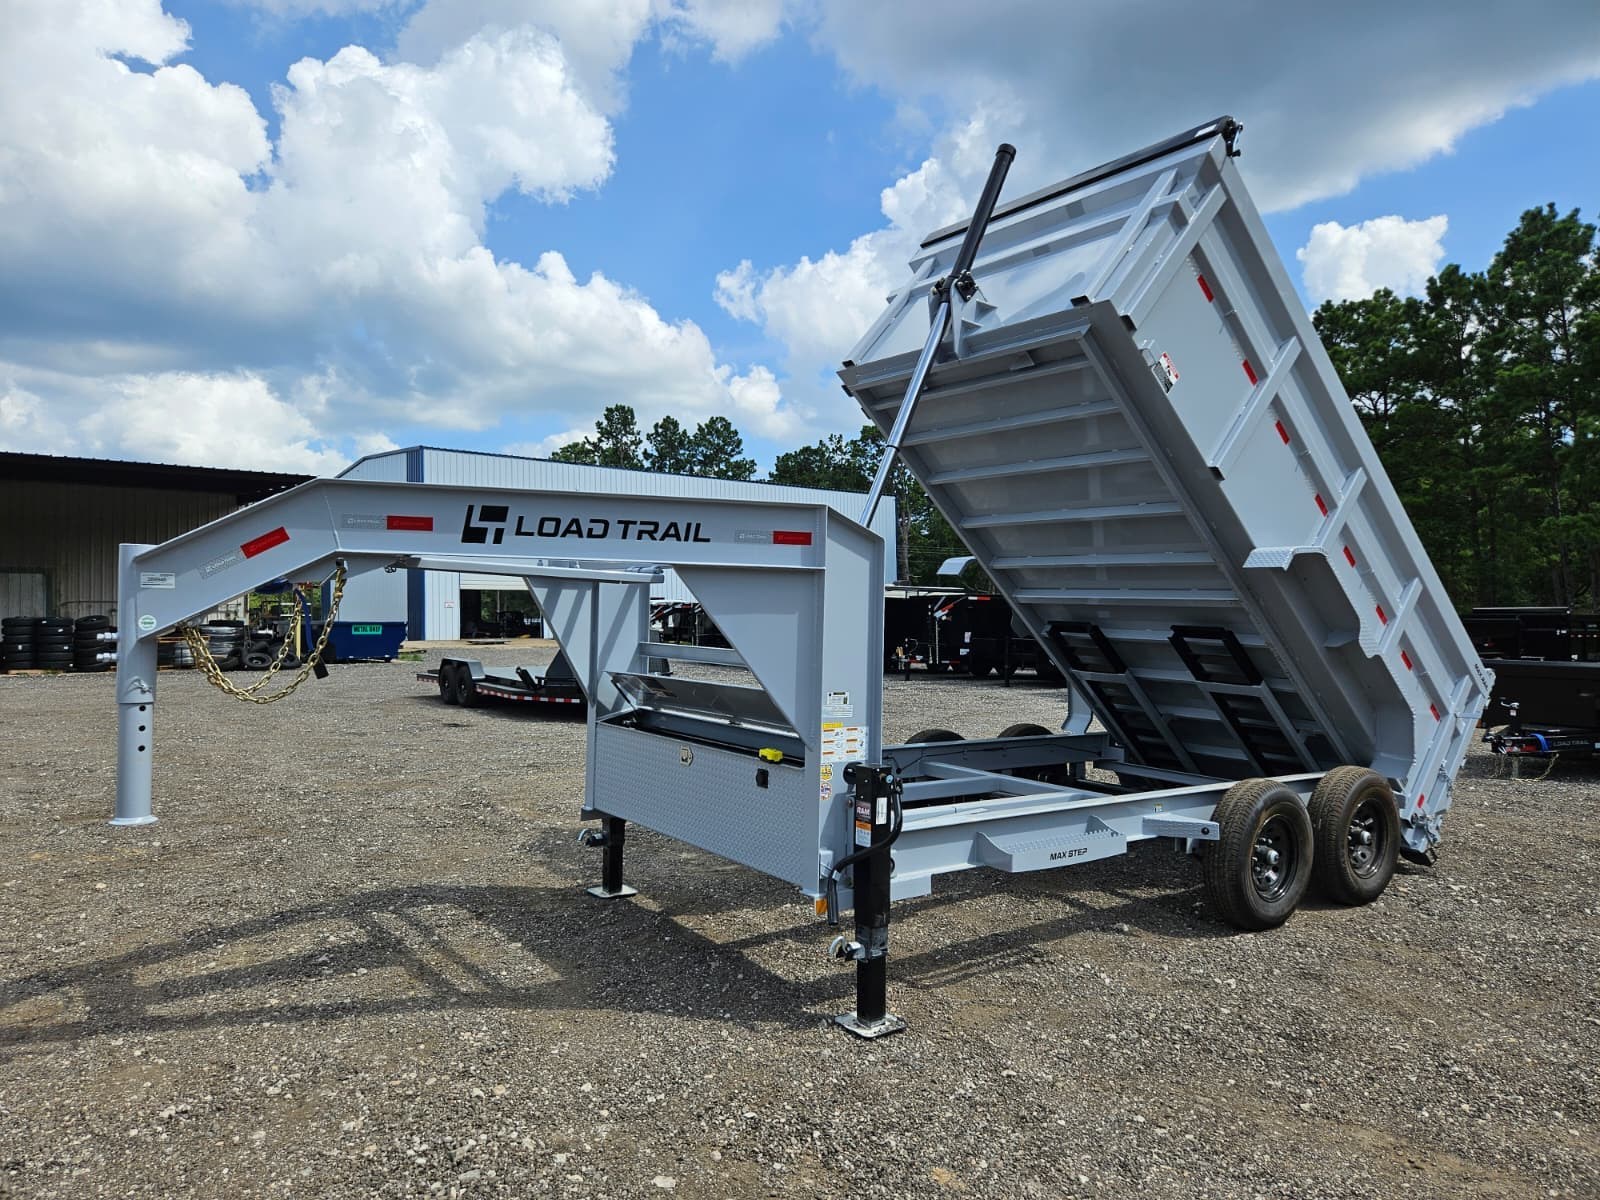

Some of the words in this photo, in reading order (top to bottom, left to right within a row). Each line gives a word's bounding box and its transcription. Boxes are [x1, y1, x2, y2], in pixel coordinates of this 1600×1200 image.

[515, 515, 611, 539] LOAD
[616, 519, 711, 543] TRAIL
[1050, 851, 1067, 860] MAX
[1068, 848, 1087, 857] STEP
